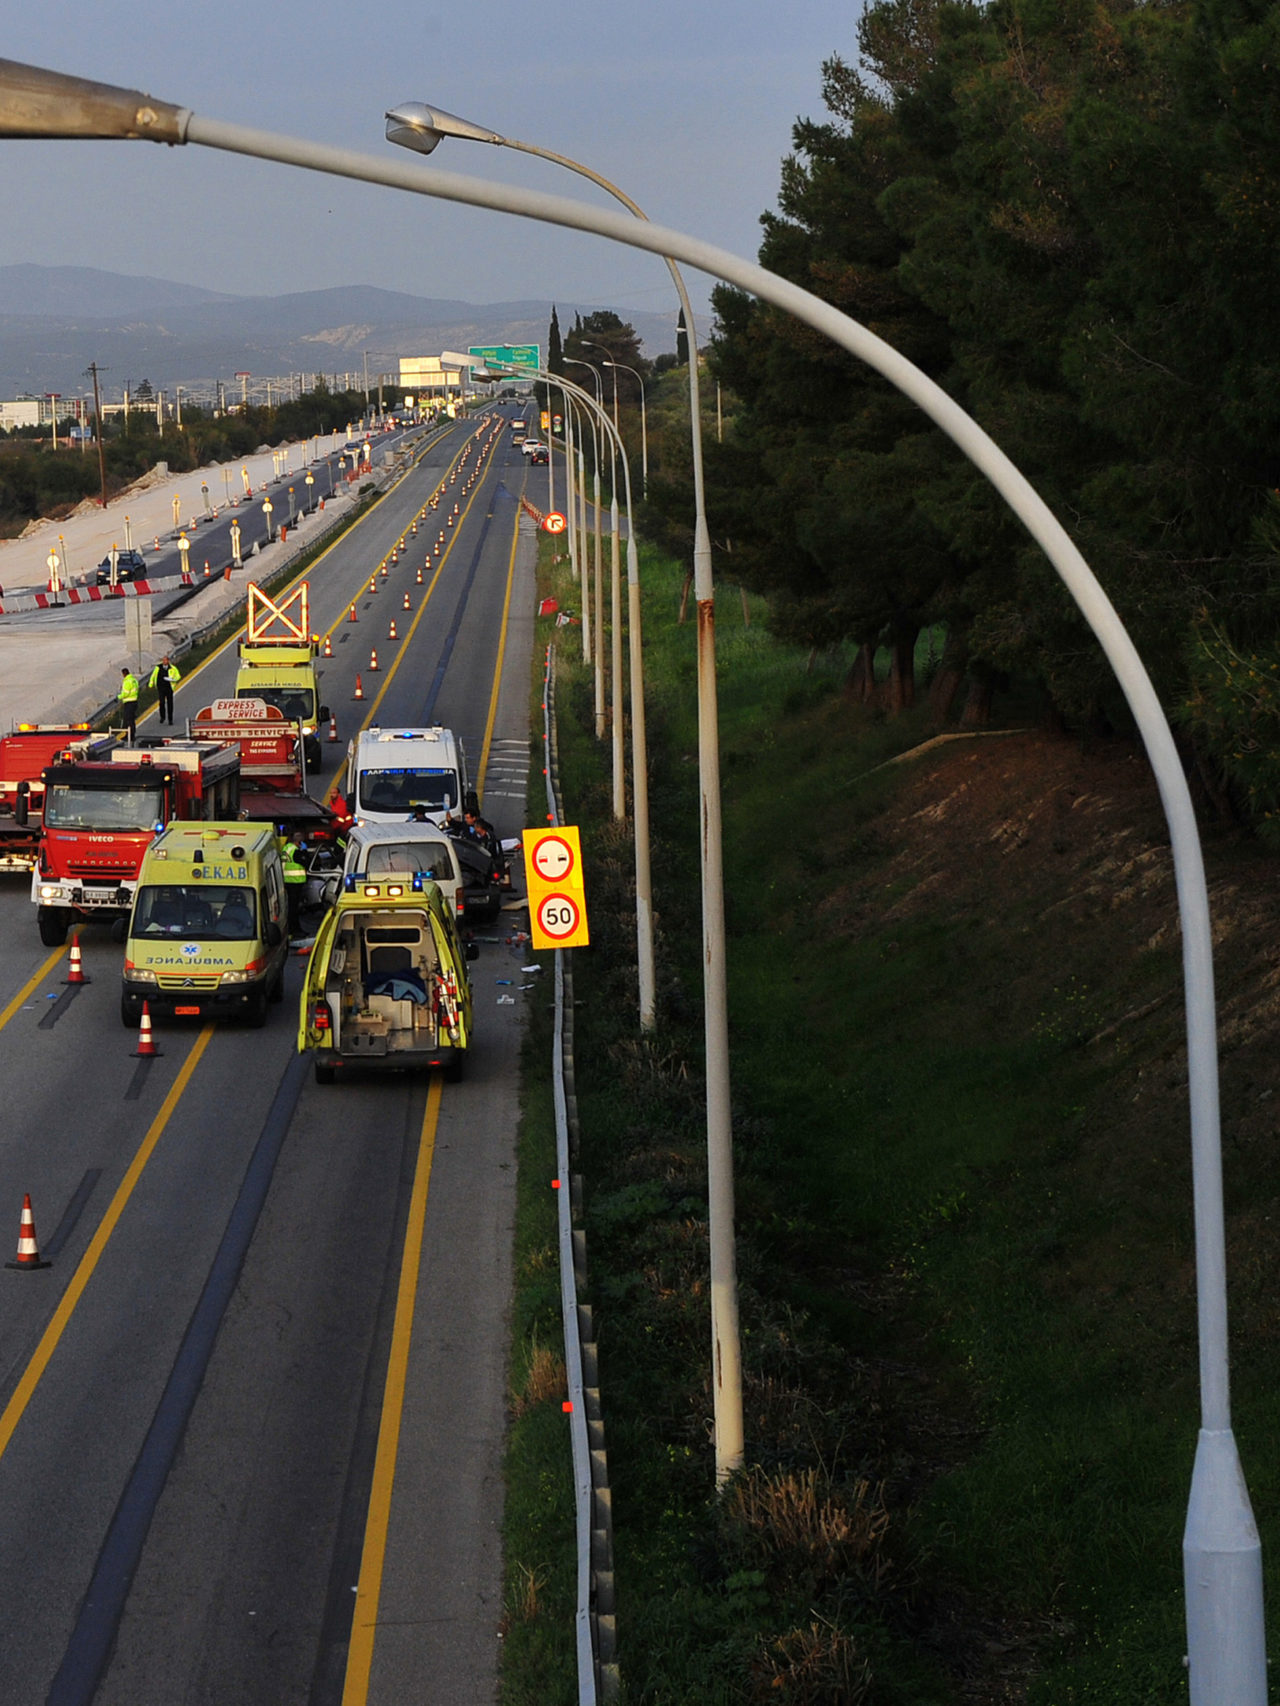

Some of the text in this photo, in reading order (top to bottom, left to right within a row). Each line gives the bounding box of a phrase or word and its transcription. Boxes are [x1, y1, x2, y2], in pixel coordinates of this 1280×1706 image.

[217, 701, 256, 710] EXPRESS
[228, 709, 264, 719] SERVICE
[198, 729, 289, 738] EXPRESS SERVICE
[88, 835, 114, 843] IVECO
[546, 907, 571, 926] 50
